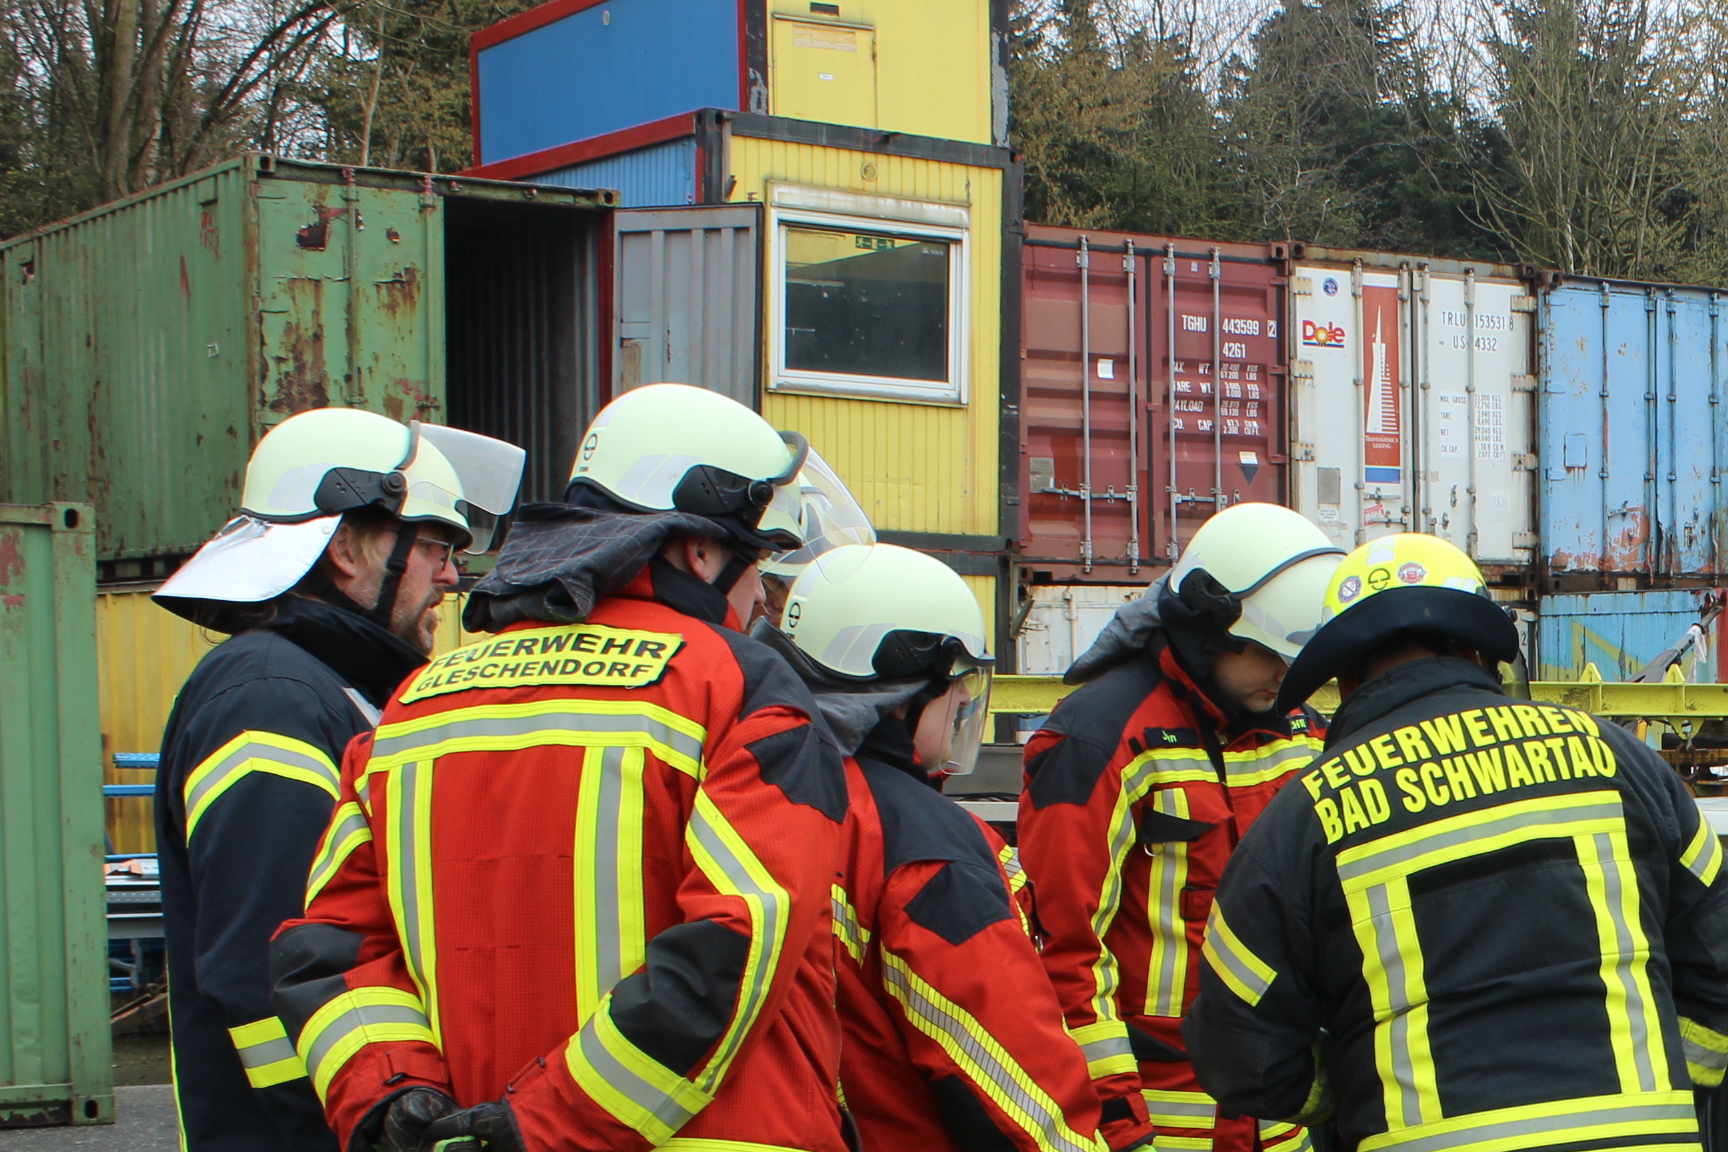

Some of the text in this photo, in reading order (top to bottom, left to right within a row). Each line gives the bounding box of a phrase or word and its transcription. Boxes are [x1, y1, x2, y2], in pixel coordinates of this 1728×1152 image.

[1181, 315, 1276, 337] TGHU 443599 2
[1441, 311, 1514, 331] TRLU 153531 8
[1302, 320, 1346, 344] Dole
[1222, 342, 1246, 358] 42G1
[1453, 335, 1497, 351] US 4332
[1246, 373, 1257, 381] LBS
[1174, 400, 1204, 412] AYLOAD
[1246, 409, 1257, 417] LBS
[1197, 419, 1214, 431] CAP.
[425, 632, 668, 675] FEUERWEHR
[415, 658, 653, 693] GLESCHENDORF
[1301, 704, 1600, 802] FEUERWEHREN
[1313, 735, 1617, 846] BAD SCHWARTAU
